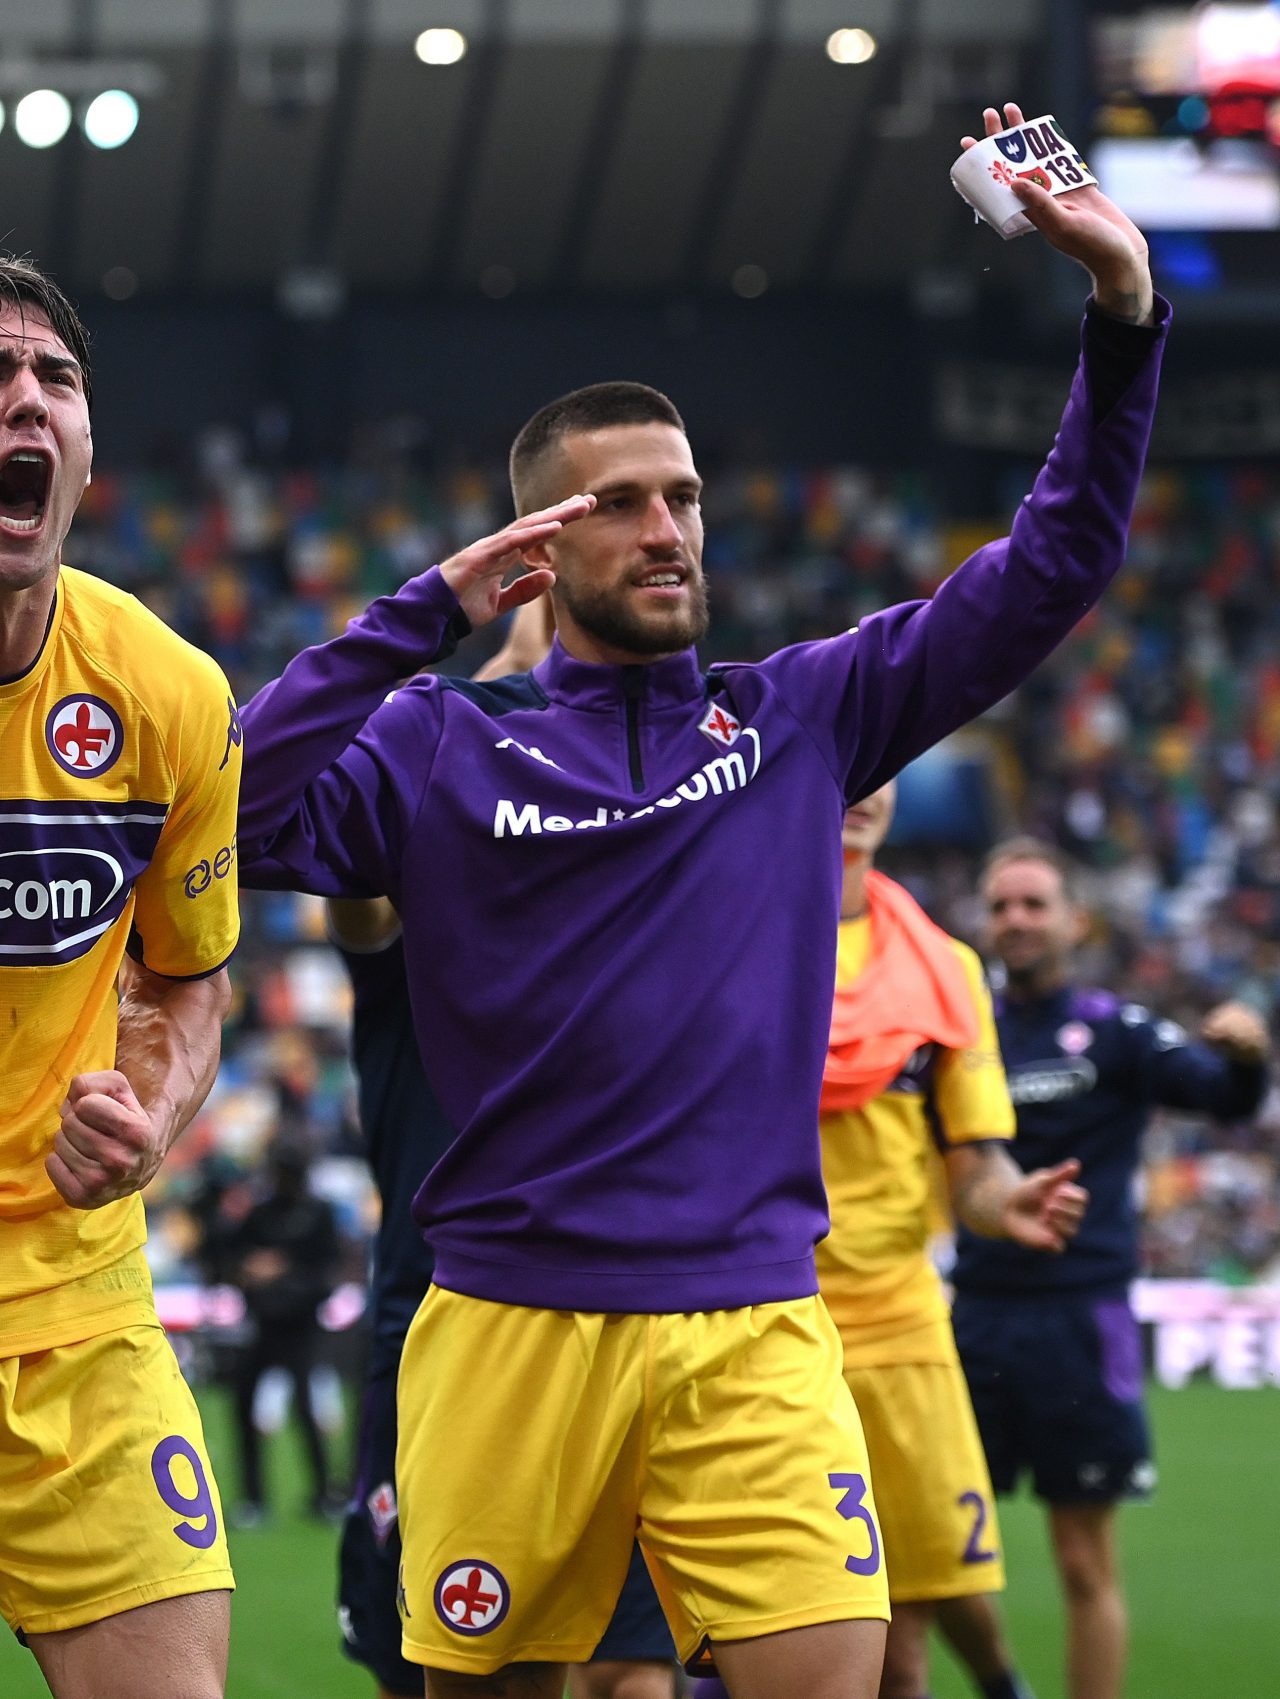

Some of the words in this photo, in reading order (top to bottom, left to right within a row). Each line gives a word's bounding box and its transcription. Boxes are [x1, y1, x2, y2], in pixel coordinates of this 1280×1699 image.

[1022, 122, 1066, 160] DA
[1045, 155, 1084, 186] 13
[151, 1434, 218, 1550] 9
[828, 1472, 881, 1577] 3
[957, 1490, 997, 1564] 2
